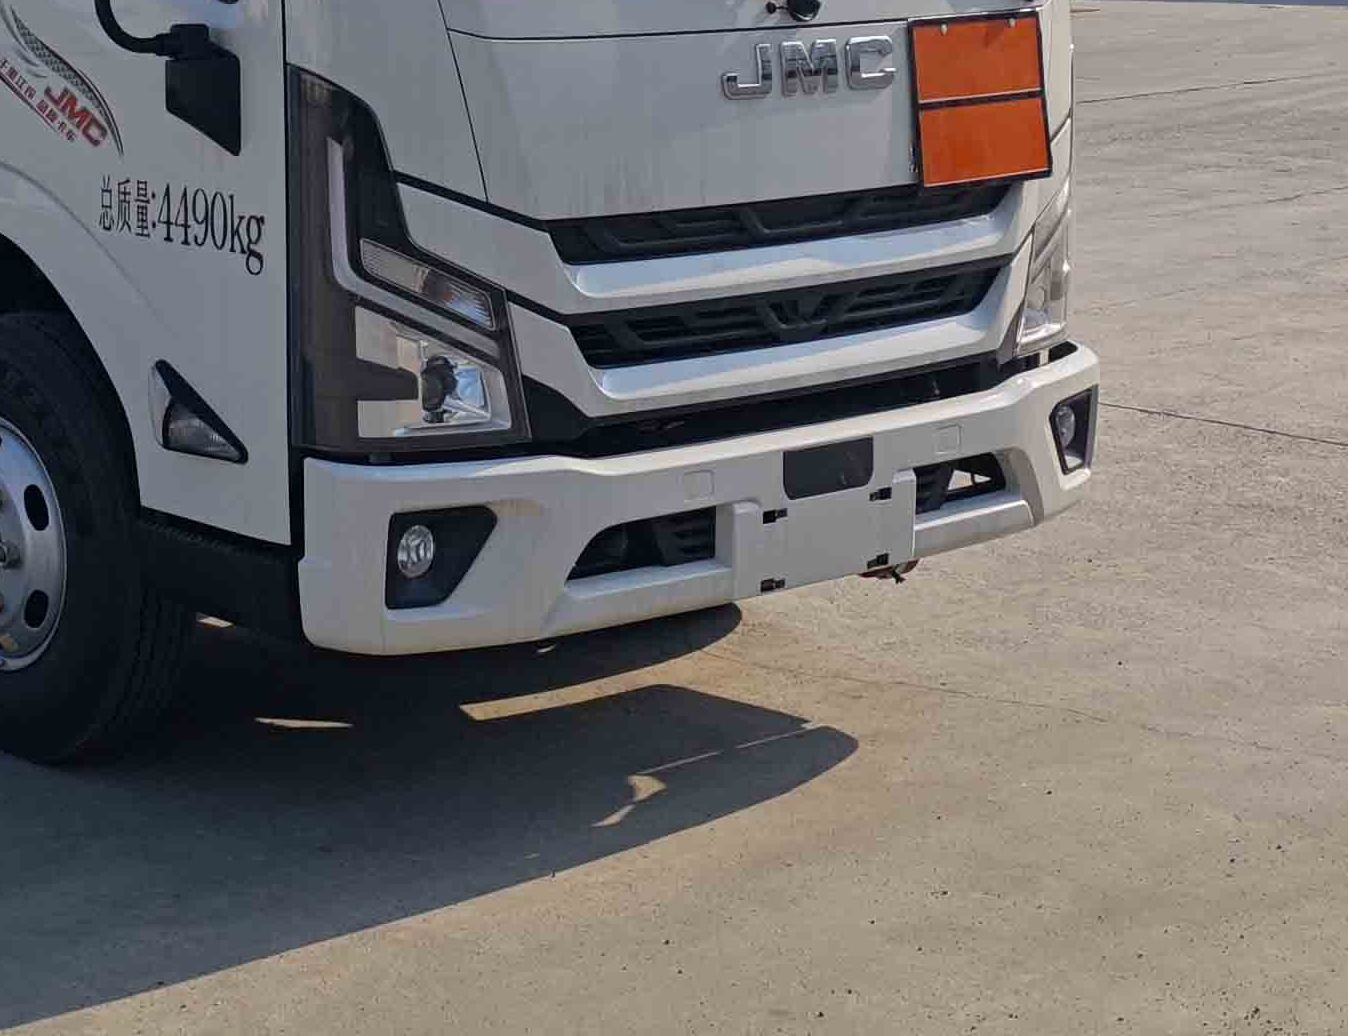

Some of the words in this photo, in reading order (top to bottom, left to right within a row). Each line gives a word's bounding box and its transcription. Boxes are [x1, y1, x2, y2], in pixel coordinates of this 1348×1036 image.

[721, 35, 897, 100] JMC
[43, 84, 109, 147] JMC
[98, 175, 265, 276] 总质量:4490kg
